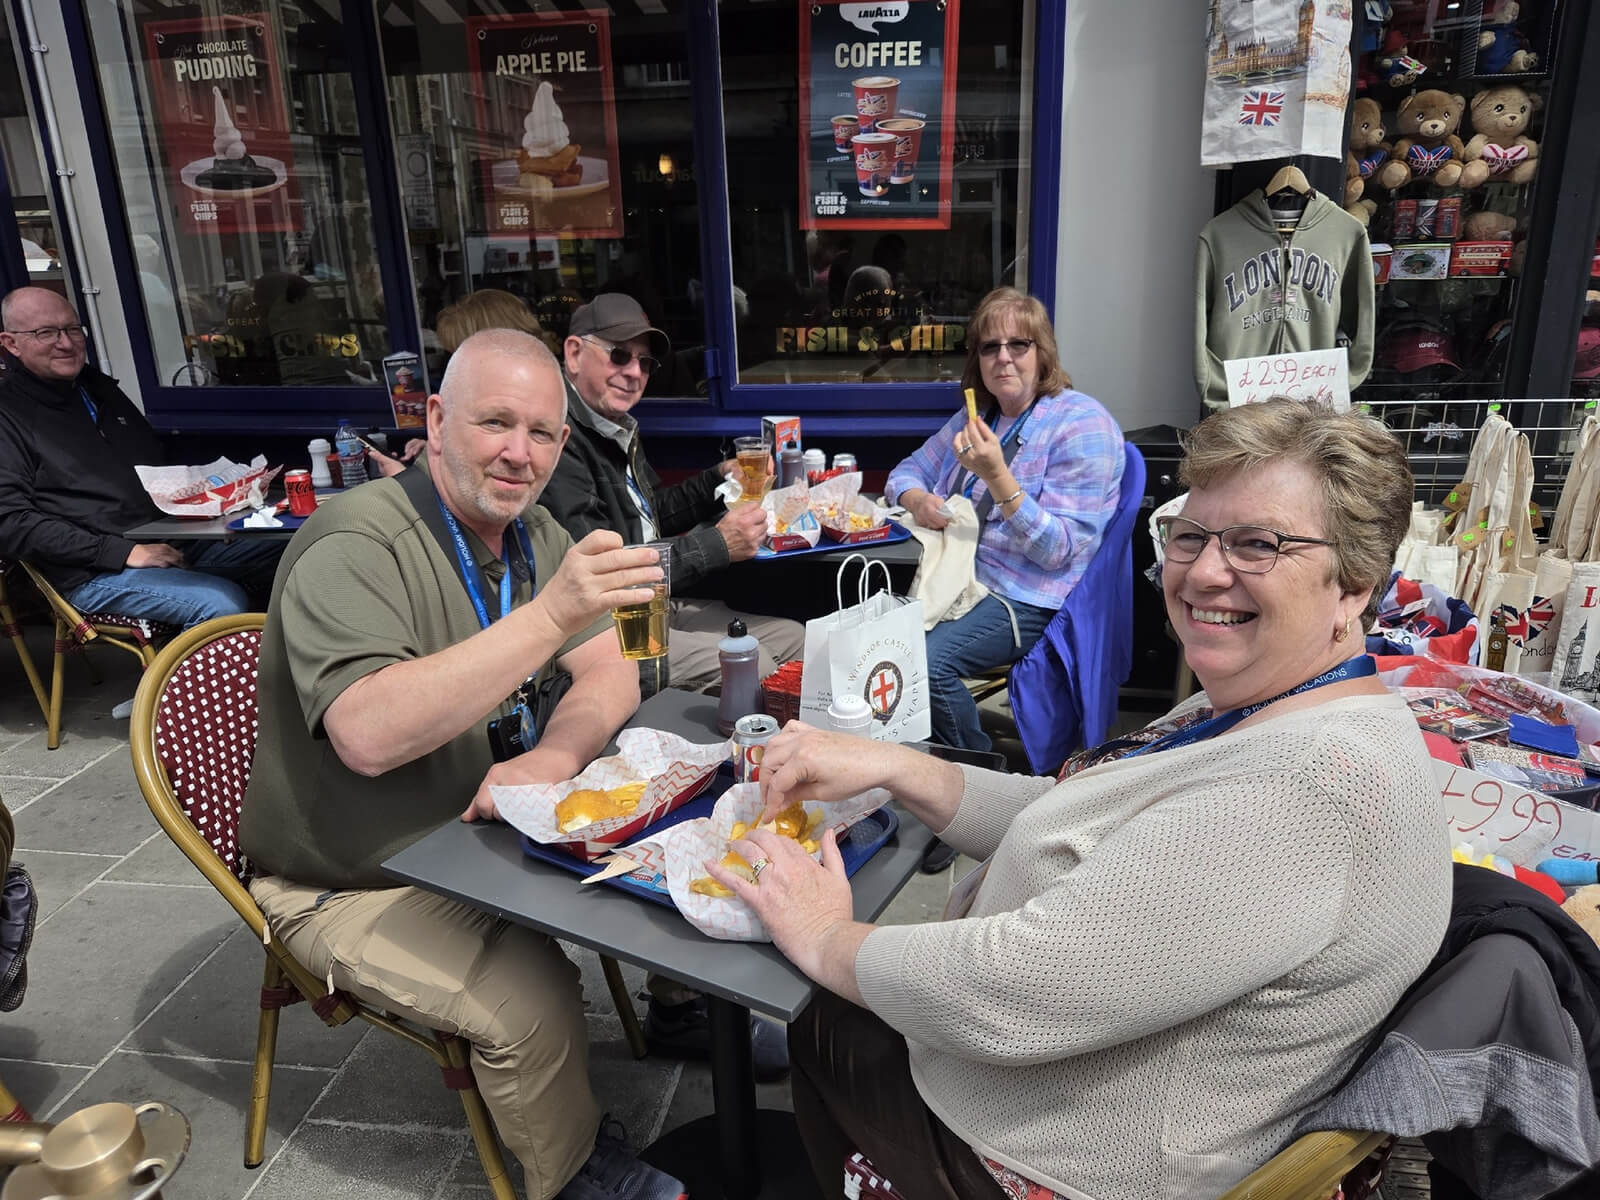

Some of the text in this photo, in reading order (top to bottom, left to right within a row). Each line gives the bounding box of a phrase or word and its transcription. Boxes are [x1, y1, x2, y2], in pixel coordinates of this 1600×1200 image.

[858, 7, 900, 18] LAVAZZA
[196, 39, 248, 54] CHOCOLATE
[834, 41, 922, 68] COFFEE
[173, 55, 257, 82] PUDDING
[495, 50, 588, 76] APPLE PIE
[815, 195, 848, 205] FISH &
[817, 205, 846, 215] CHIPS
[1223, 247, 1339, 313] LONDON
[832, 307, 873, 318] GREAT
[1241, 305, 1313, 330] ENGLAND
[776, 324, 969, 353] FISH & CHIP
[1301, 364, 1338, 381] EACH
[847, 637, 913, 683] WINDSOR CASTLE
[1291, 666, 1347, 697] VACATIONS
